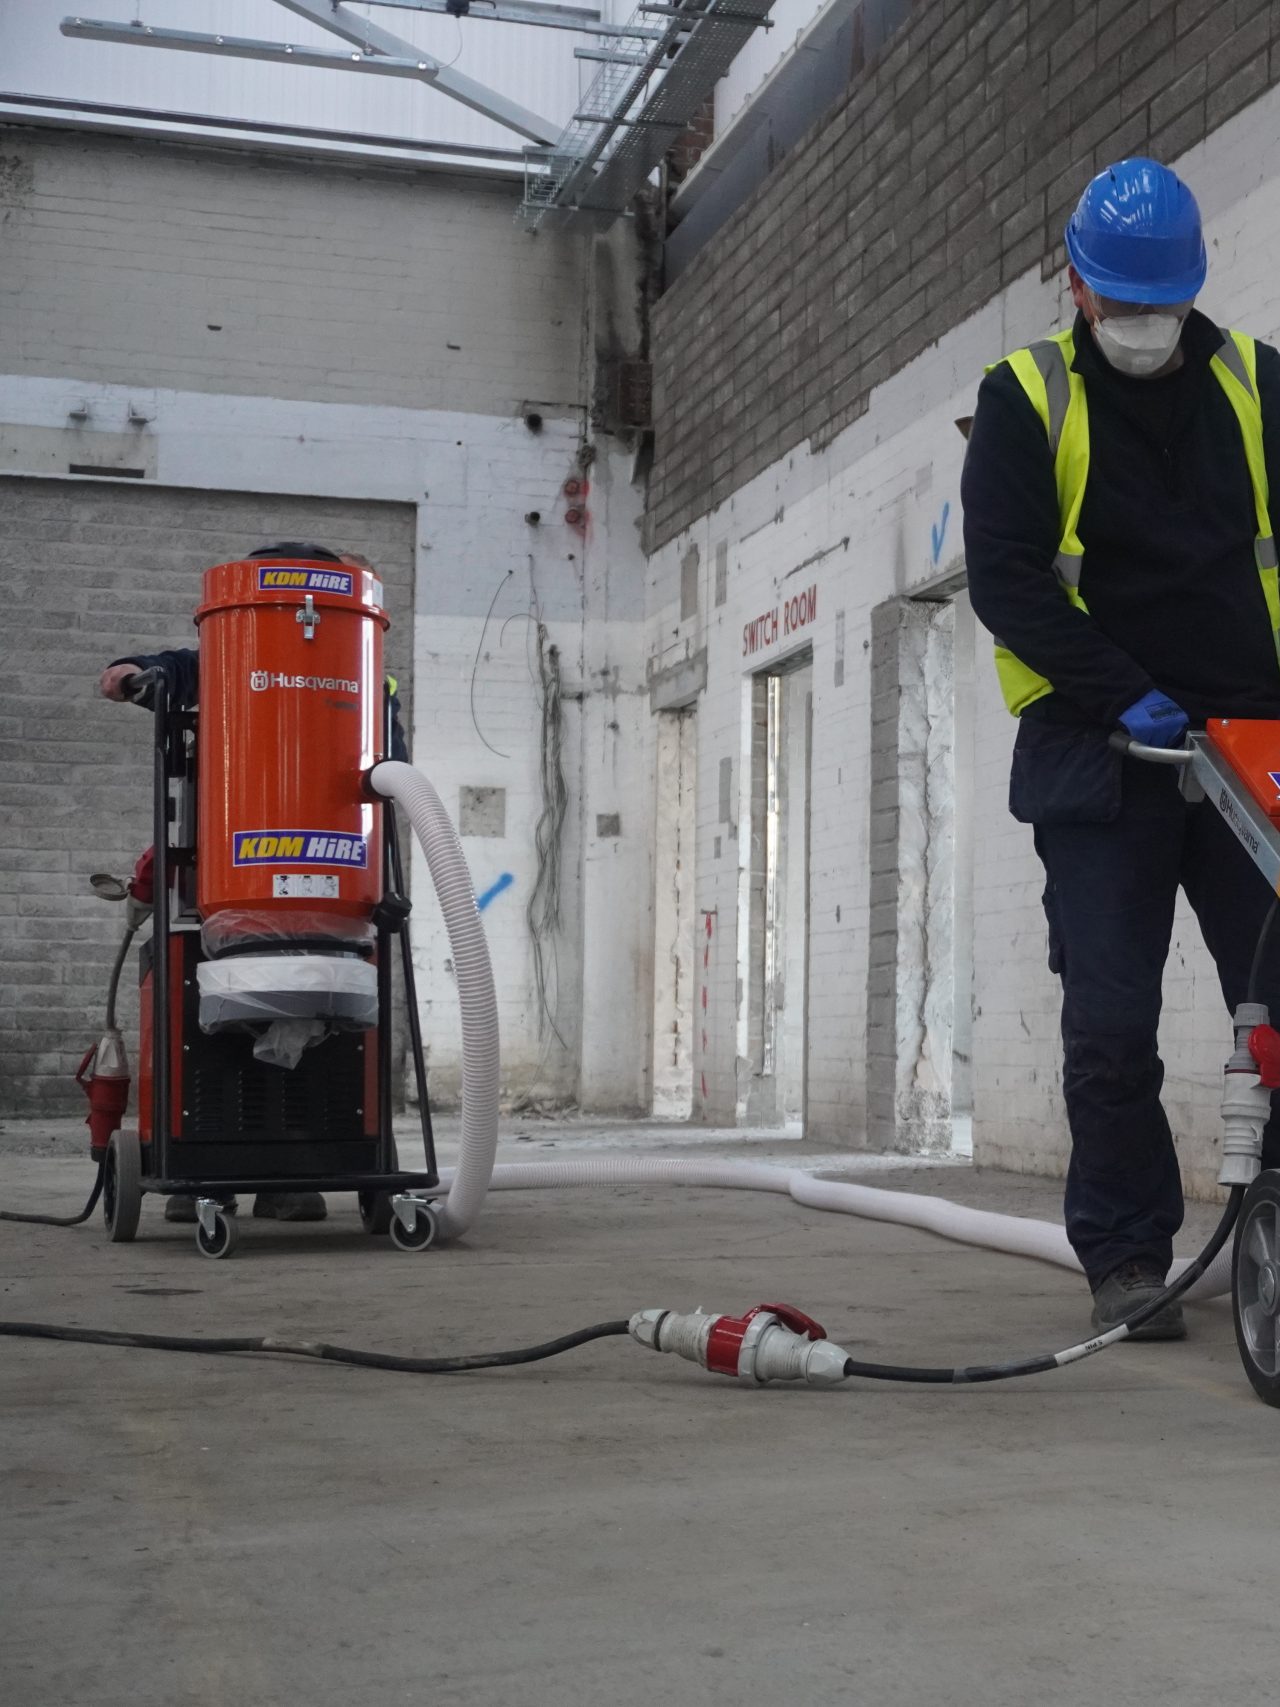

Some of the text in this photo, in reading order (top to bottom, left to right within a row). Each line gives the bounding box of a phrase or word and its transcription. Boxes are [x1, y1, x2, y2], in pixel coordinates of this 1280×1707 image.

[263, 572, 307, 586] KDM
[743, 583, 817, 657] SWITCH ROOM
[271, 672, 358, 693] Husqvarna
[239, 836, 304, 859] KDM
